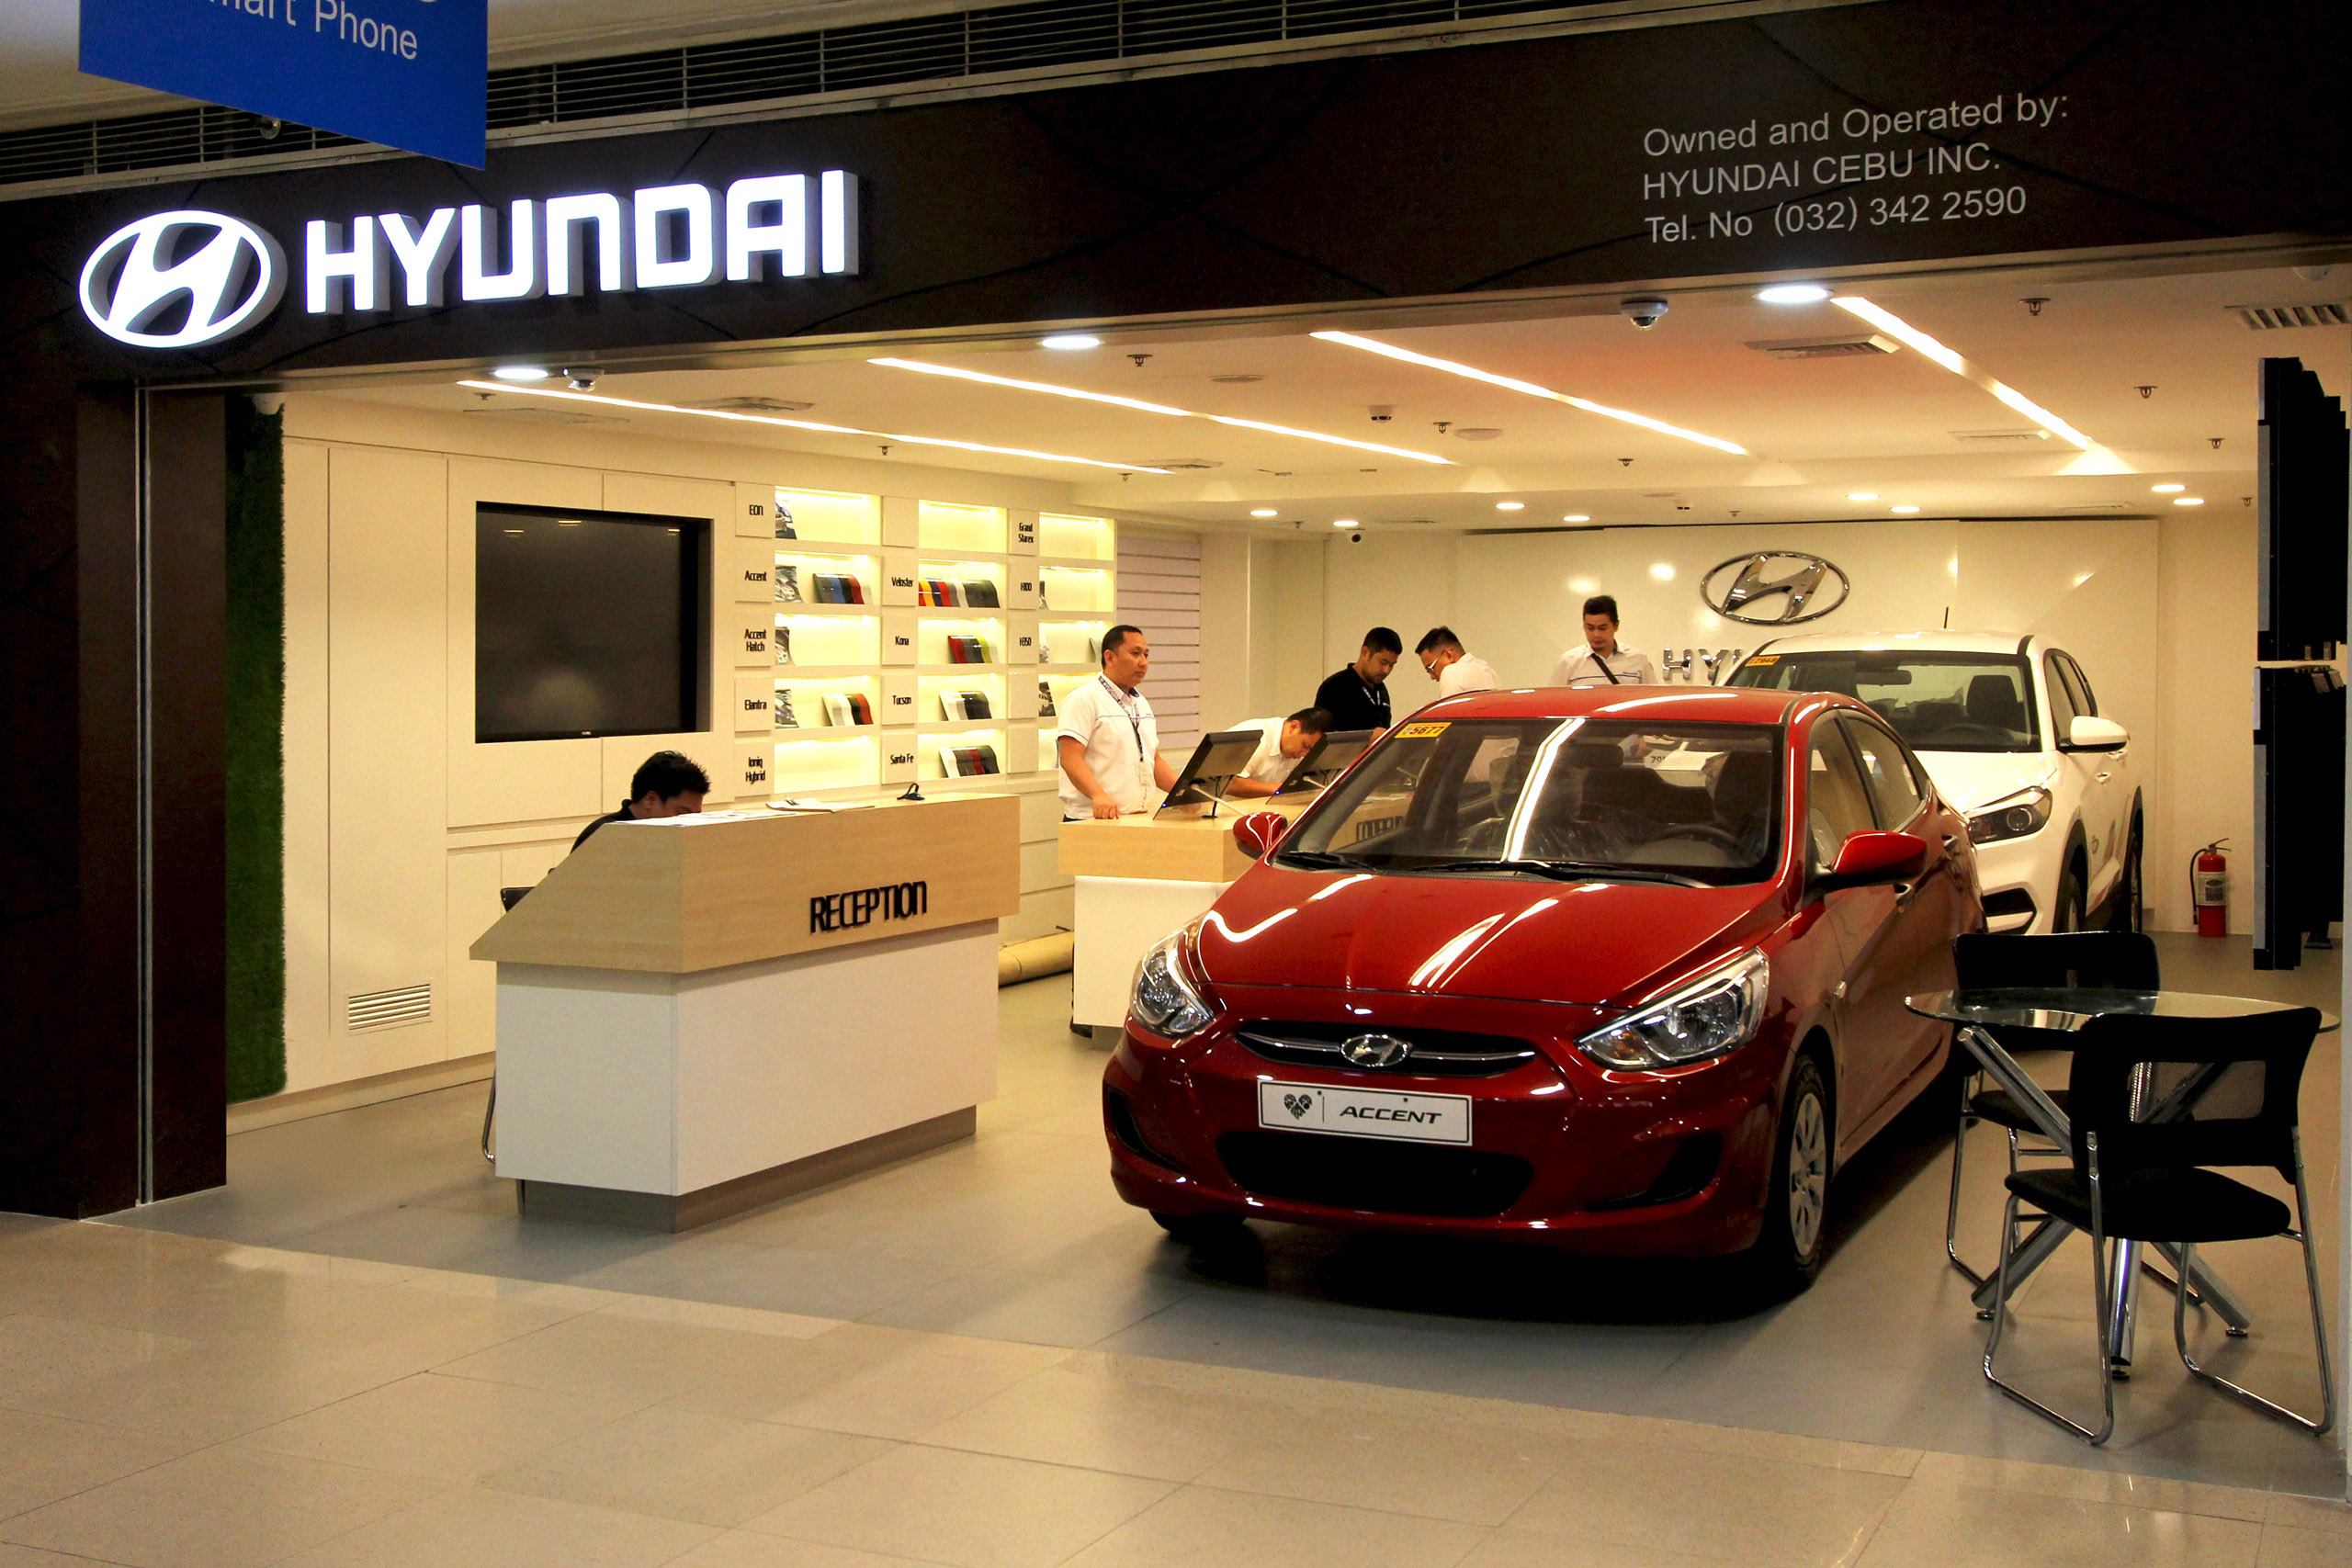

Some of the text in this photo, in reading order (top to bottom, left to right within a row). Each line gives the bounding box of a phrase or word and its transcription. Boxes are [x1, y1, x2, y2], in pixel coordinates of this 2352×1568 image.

[315, 0, 418, 60] Phone
[1644, 93, 2068, 157] Owned and Operated by:
[1644, 142, 2000, 200] HYUNDAI CEBU INC.
[1645, 186, 2027, 243] Tel. No (032) 342 2590
[306, 169, 854, 314] HYUNDAI
[744, 570, 767, 582] Accent
[891, 577, 914, 588] Veloster
[744, 628, 767, 640] Accent
[745, 640, 765, 652] Hatch
[895, 636, 910, 646] Kona
[1662, 649, 1742, 682] HY
[744, 699, 767, 711] Elantra
[892, 694, 912, 705] Tucson
[1409, 726, 1445, 734] 5677
[748, 756, 763, 769] Ioniq
[890, 752, 914, 765] Santa Fe
[745, 770, 766, 785] Hybrid
[809, 880, 928, 934] RECEPTION
[1339, 1106, 1442, 1124] ACCENT
